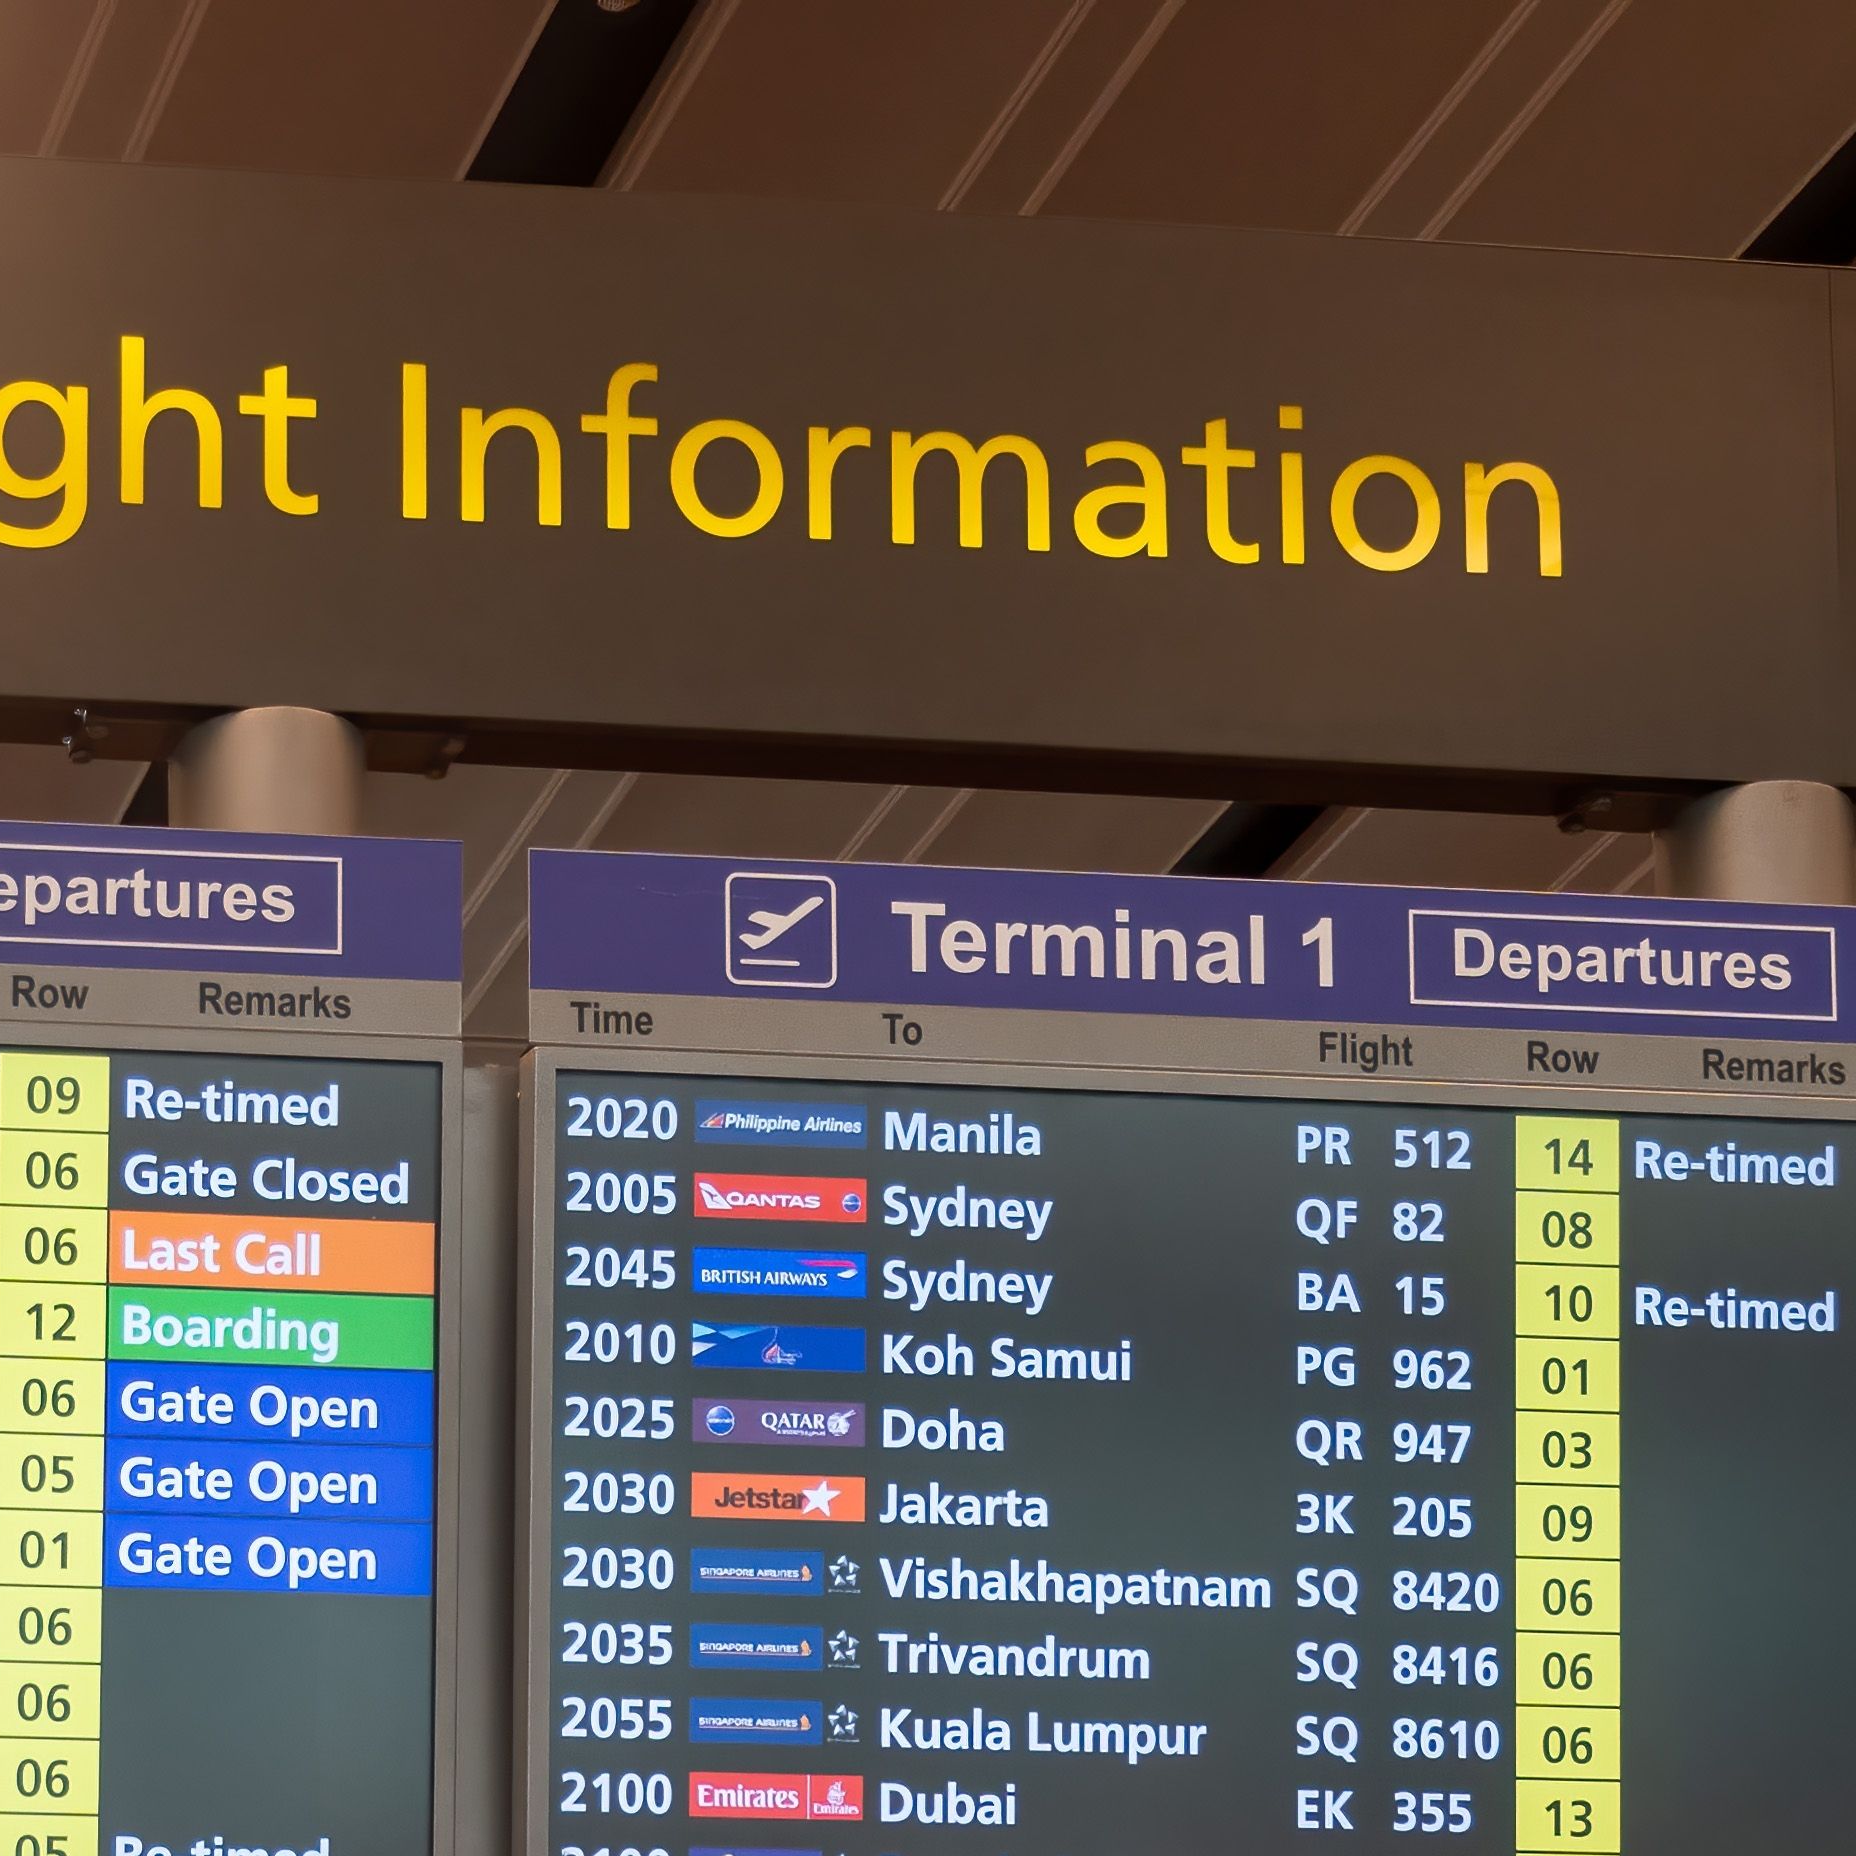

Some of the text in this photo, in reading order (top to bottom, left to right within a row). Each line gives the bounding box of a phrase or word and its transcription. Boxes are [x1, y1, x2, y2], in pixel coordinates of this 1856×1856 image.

[403, 363, 1562, 577] Information
[892, 902, 1791, 992] Terminal 1 Departures
[13, 975, 89, 1009] Row
[200, 982, 351, 1019] Remarks
[570, 1001, 1845, 1085] Time To Flight Row Remarks
[28, 1076, 80, 1114] 09
[127, 1079, 338, 1126] Re-timed
[568, 1097, 1833, 1186] 2020 Philippine Airlines Manila PR 512 14 Re-timed
[26, 1152, 78, 1190] 06
[125, 1154, 237, 1197] Gate
[253, 1158, 408, 1204] Closed
